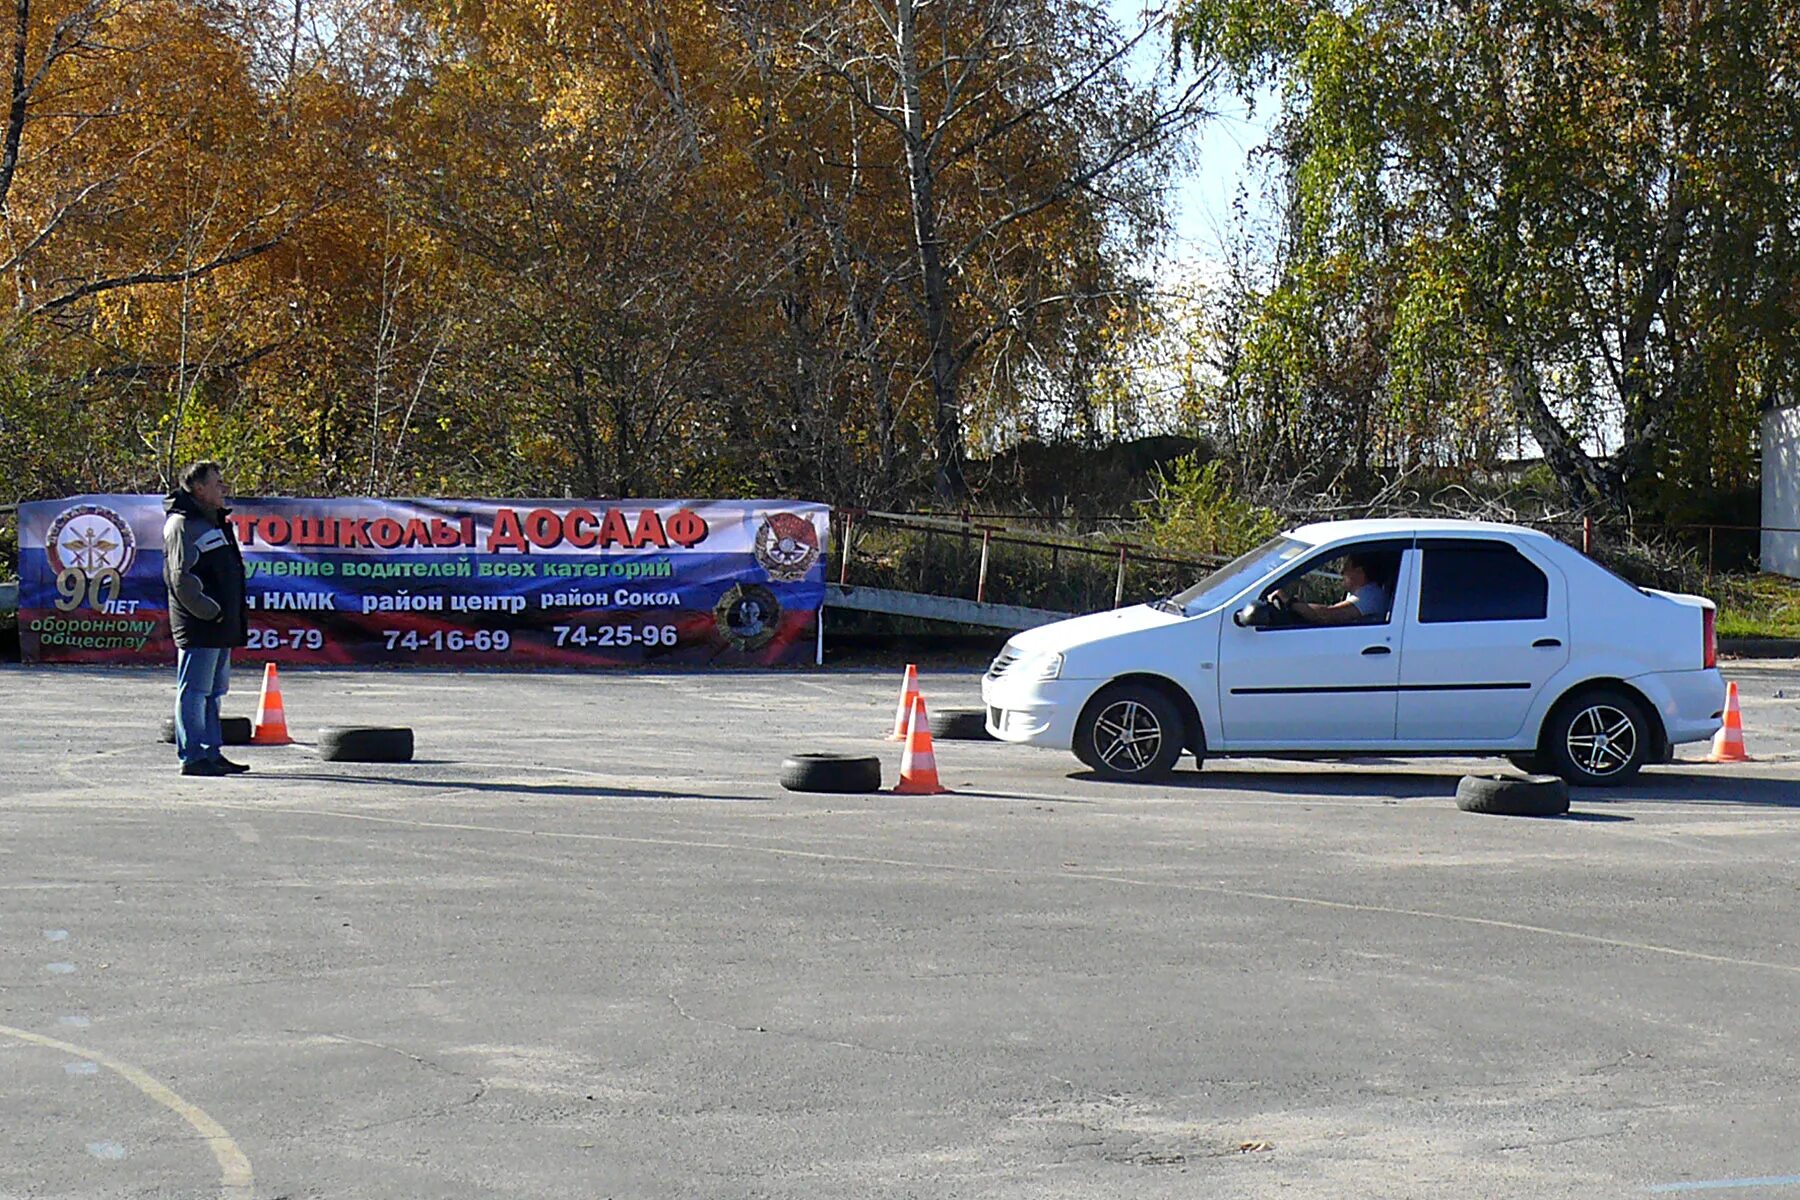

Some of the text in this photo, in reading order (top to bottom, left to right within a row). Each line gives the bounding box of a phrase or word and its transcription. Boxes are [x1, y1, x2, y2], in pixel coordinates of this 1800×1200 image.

[230, 507, 707, 553] тошколы ДОСААФ
[242, 557, 672, 579] учение водителей всех категорий
[54, 567, 121, 612] 90
[263, 591, 335, 610] НЛМК
[541, 587, 681, 609] район Сокол
[101, 599, 140, 615] ЛЕТ
[362, 589, 526, 614] район центр
[30, 616, 156, 636] оборонному
[553, 624, 678, 647] 74-25-96
[40, 633, 147, 652] обществу
[244, 628, 323, 649] 26-79
[383, 629, 510, 651] 74-16-69
